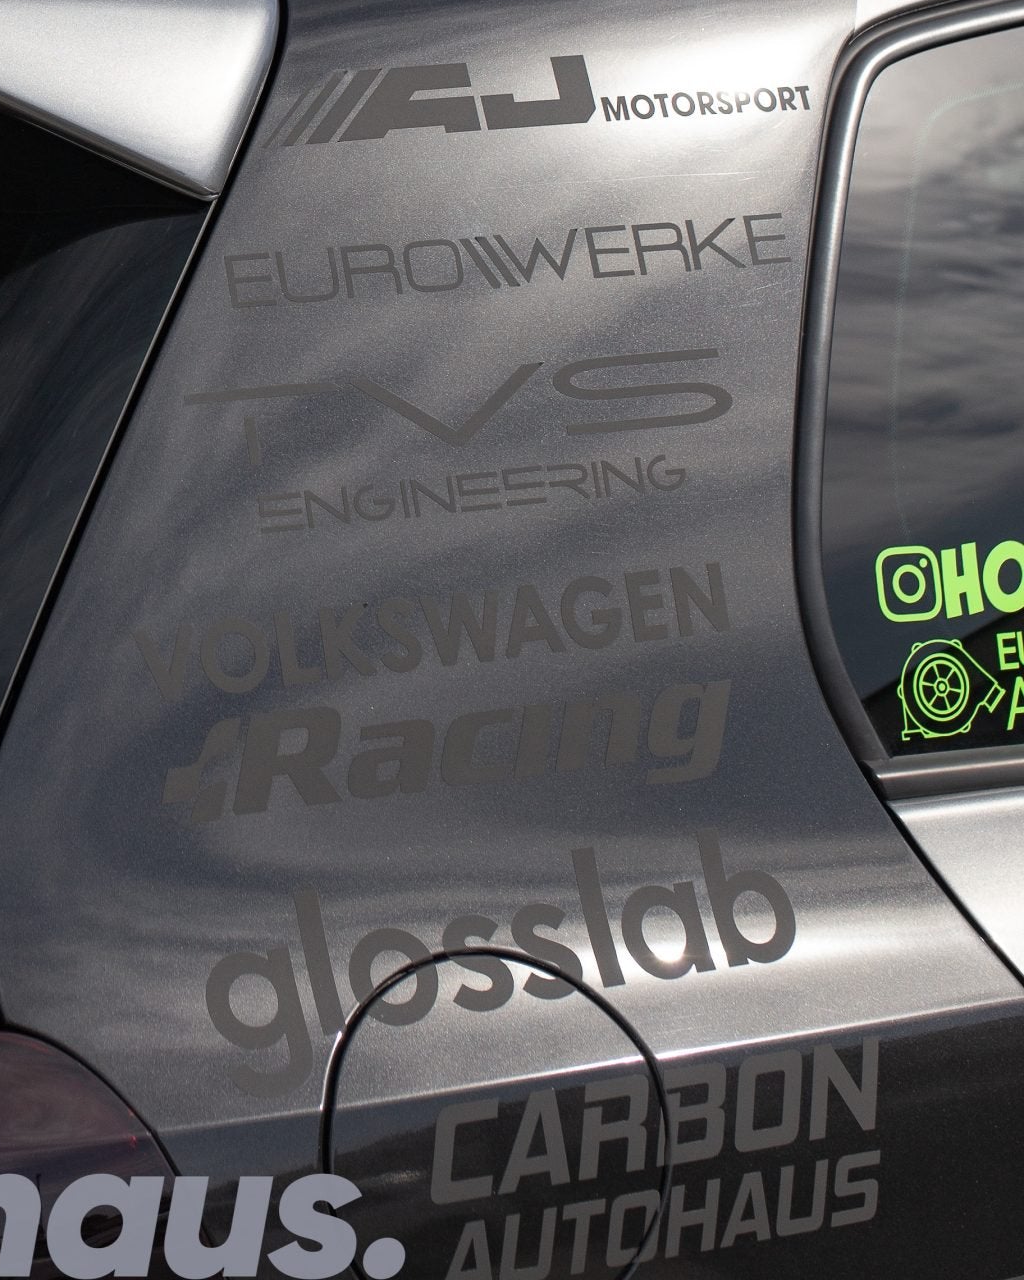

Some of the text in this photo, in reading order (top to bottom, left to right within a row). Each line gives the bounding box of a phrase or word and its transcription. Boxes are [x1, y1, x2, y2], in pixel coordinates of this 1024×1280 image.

[601, 85, 812, 123] MOTORSPORT
[183, 348, 733, 466] TVS
[257, 454, 687, 534] ENGINEERING
[134, 562, 730, 702] VOLKSWAGEN
[230, 678, 732, 817] Racing
[205, 827, 797, 1099] glosslab
[430, 1037, 880, 1205] CARBON
[443, 1150, 881, 1280] AUTOHAUS
